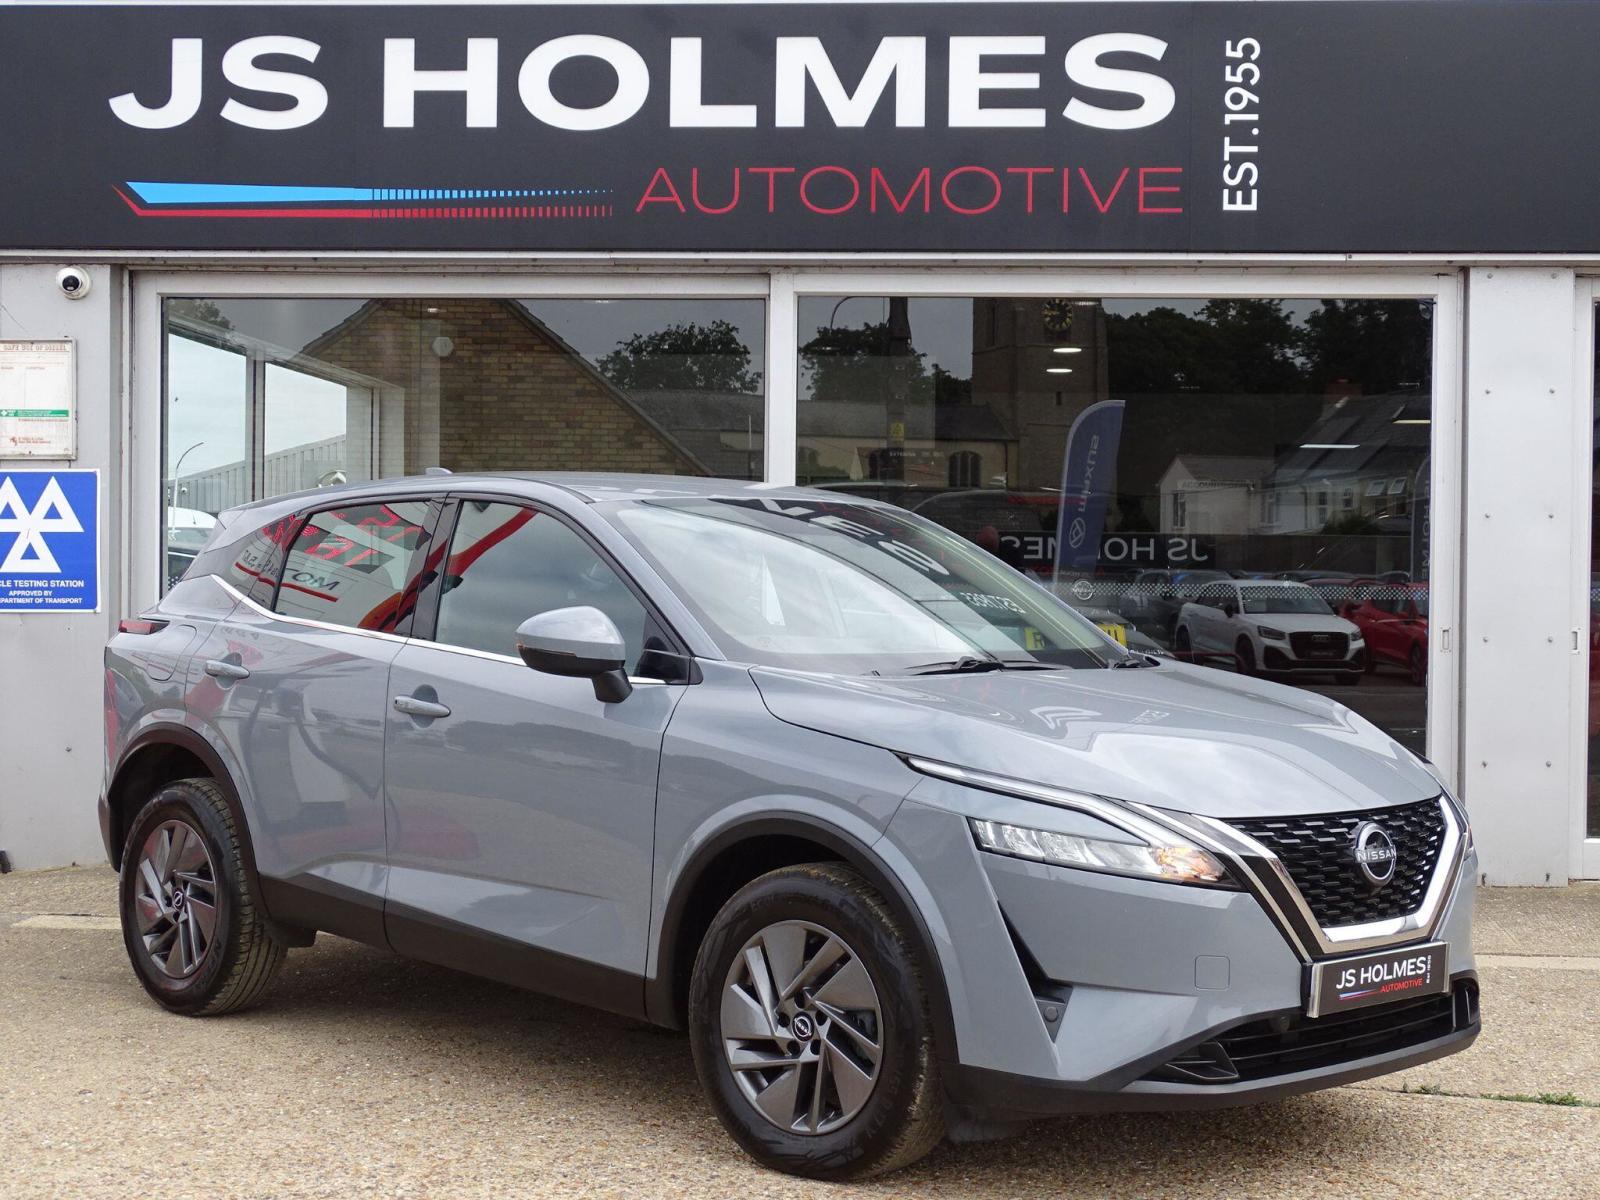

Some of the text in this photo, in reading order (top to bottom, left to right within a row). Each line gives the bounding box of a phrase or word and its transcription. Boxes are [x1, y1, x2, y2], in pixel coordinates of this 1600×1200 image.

[108, 33, 1176, 131] JS HOLMES
[1222, 37, 1261, 212] EST.1955
[635, 166, 1184, 215] AUTOMOTIVE
[13, 580, 49, 588] TESTING
[50, 580, 84, 588] STATION
[1356, 848, 1397, 862] NISSAN
[1335, 956, 1427, 989] JS HOLMES
[1379, 978, 1423, 993] AUTOMOTIVE
